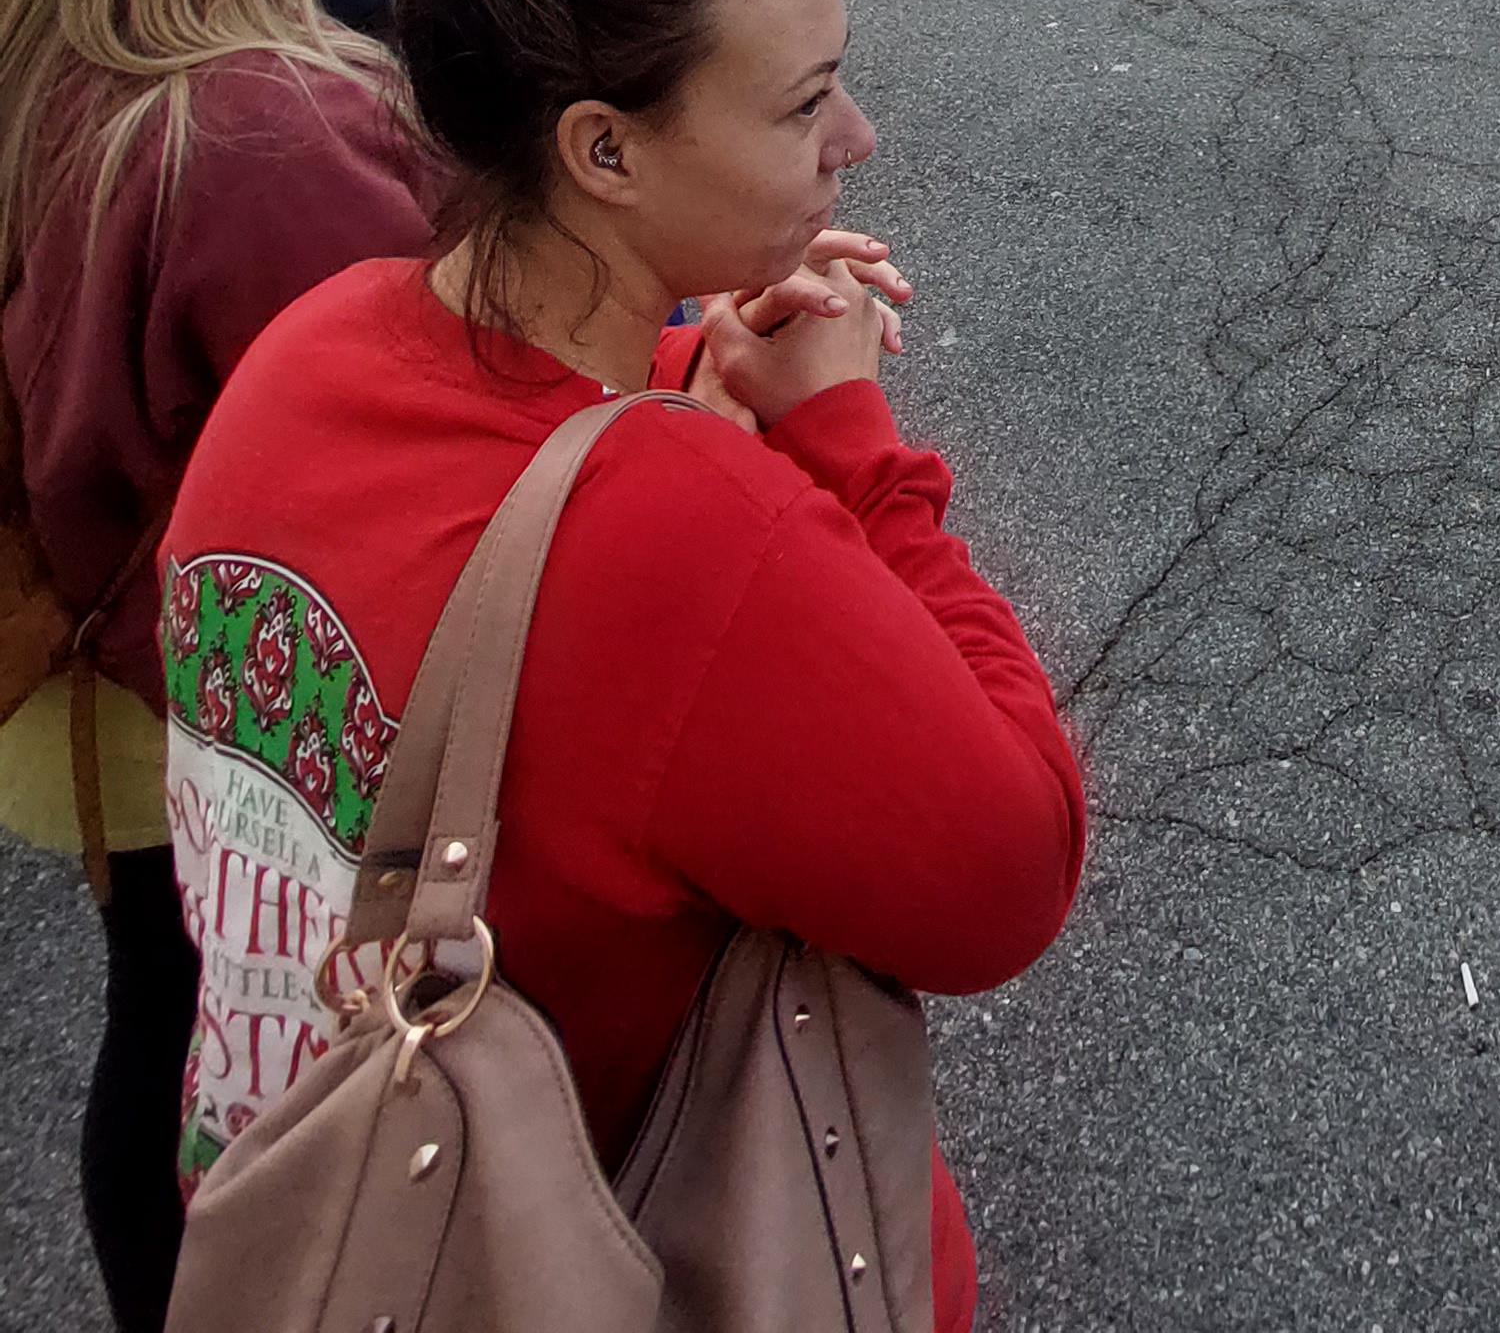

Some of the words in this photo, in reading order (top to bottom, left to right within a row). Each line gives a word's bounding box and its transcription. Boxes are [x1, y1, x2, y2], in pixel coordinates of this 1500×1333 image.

[228, 769, 289, 826] HAVE
[213, 797, 299, 866] URSELF
[307, 852, 321, 882] A
